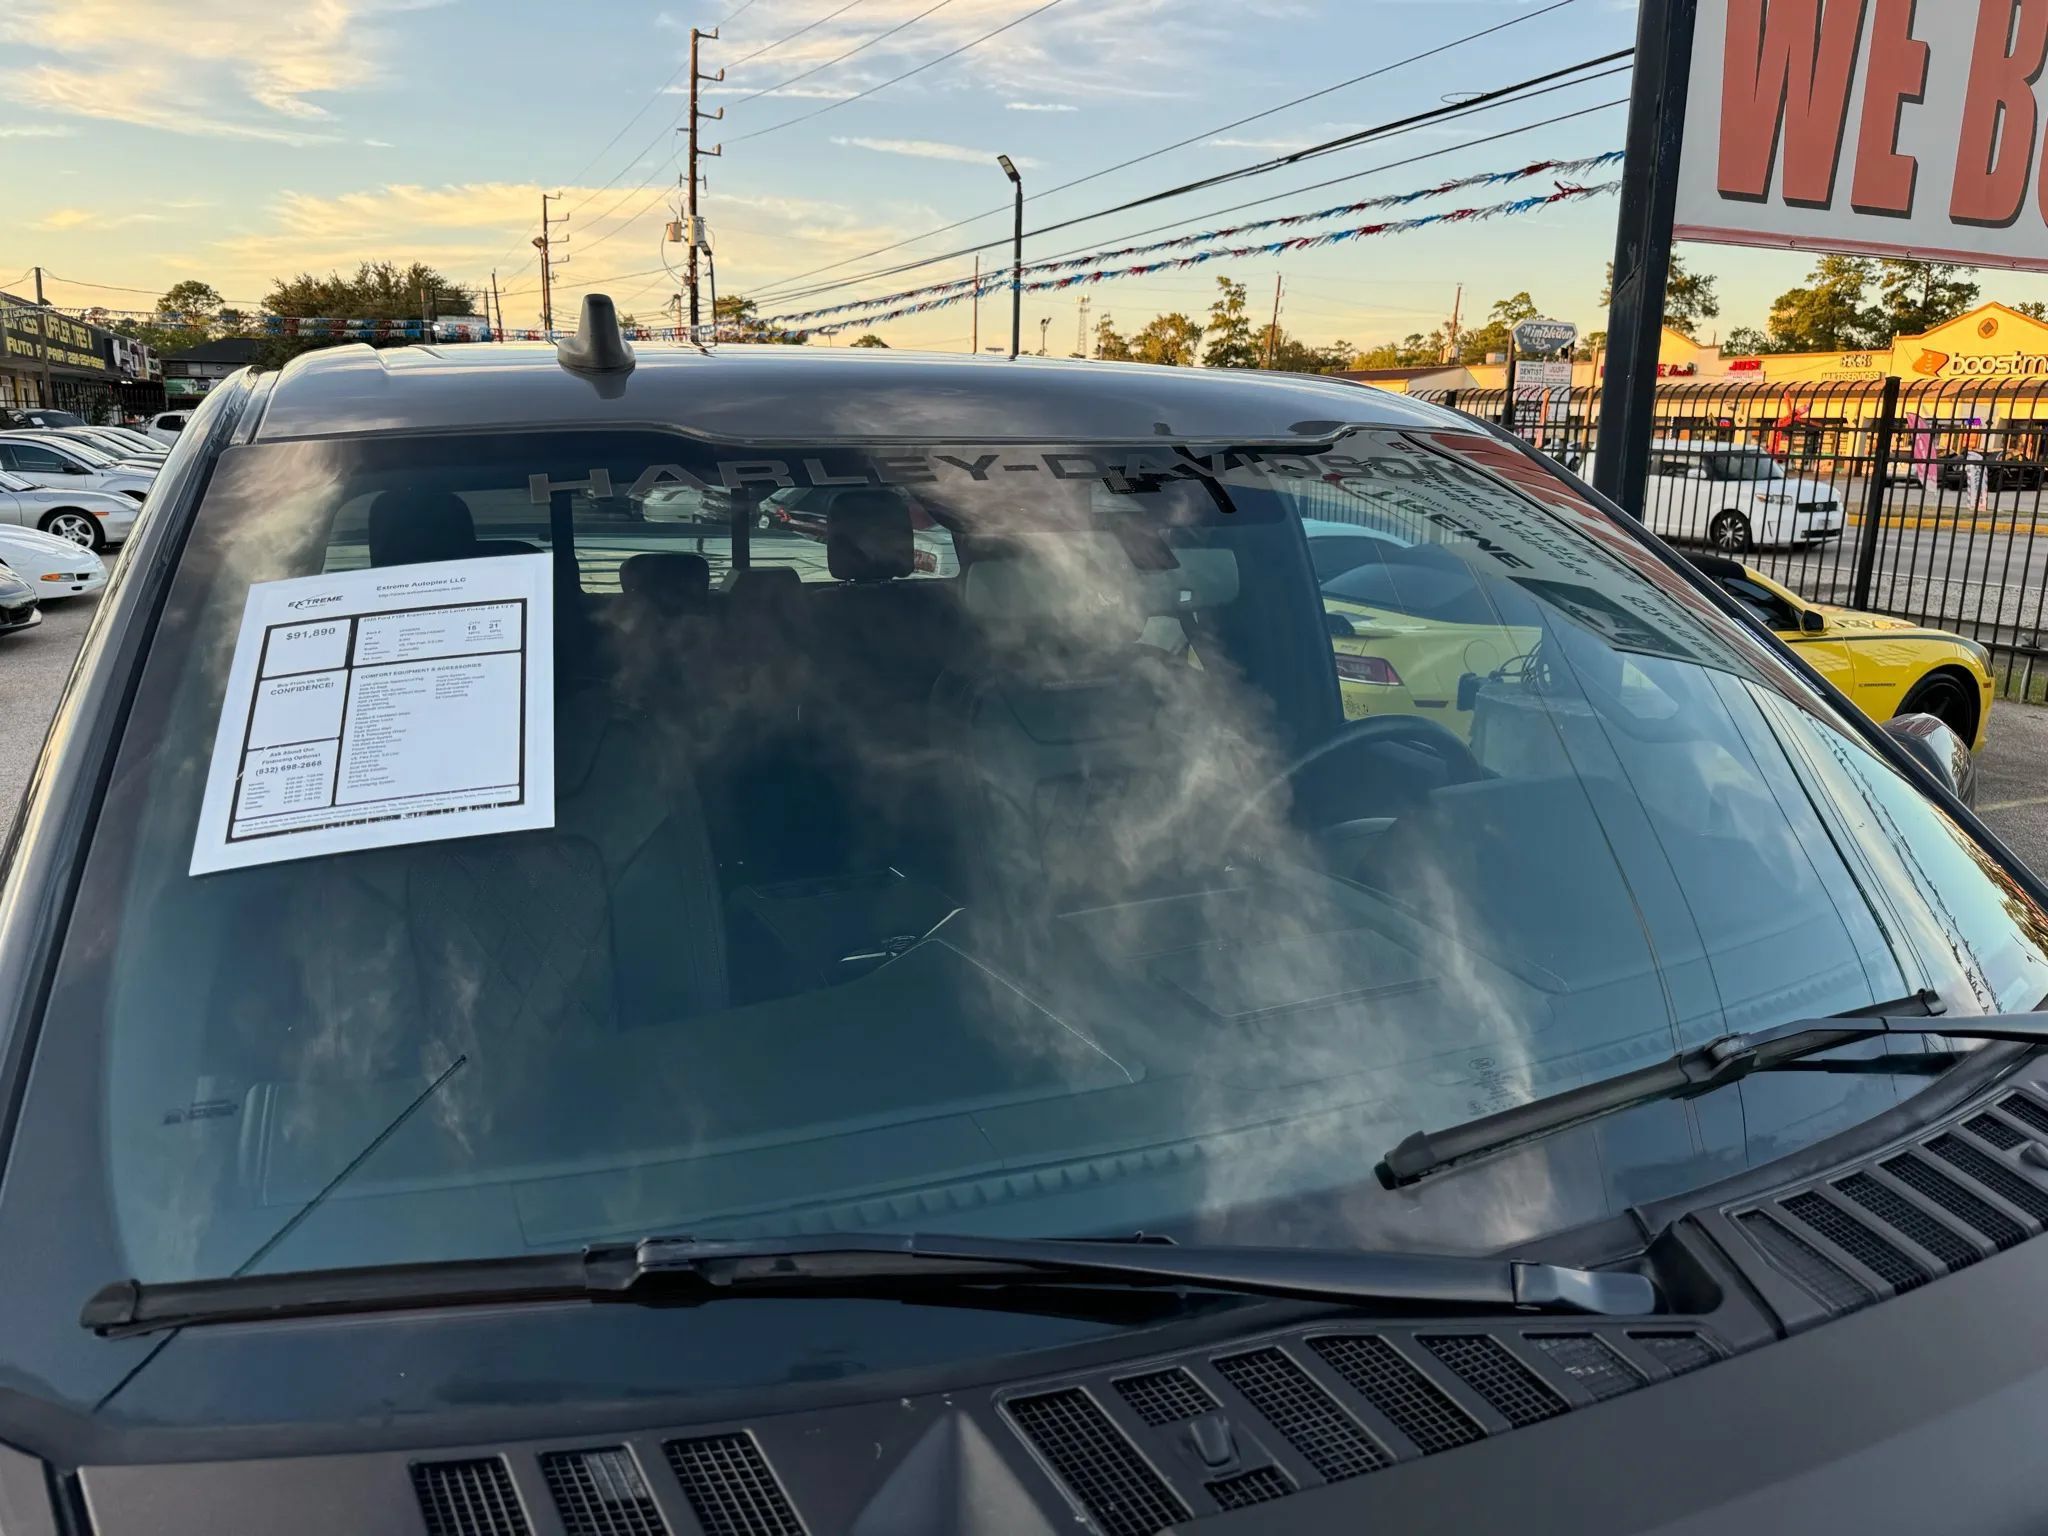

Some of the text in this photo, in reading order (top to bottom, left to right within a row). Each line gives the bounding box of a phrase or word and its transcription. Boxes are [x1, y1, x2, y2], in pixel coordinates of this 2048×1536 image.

[1717, 0, 2048, 229] WE B
[1521, 324, 1574, 340] Wimbledon
[6, 335, 34, 357] AUTO
[1950, 350, 2048, 376] boostm
[1519, 368, 1543, 377] DENTIST
[376, 576, 467, 592] Extreme Autoplex LLC
[287, 594, 344, 611] EXTREME
[286, 626, 336, 641] $91,890
[361, 671, 392, 680] COMFORT
[393, 668, 430, 677] EQUIPMENT
[437, 662, 483, 672] ACCESSORIES
[270, 681, 335, 696] CONFIDENCE!
[255, 764, 279, 777] (832)
